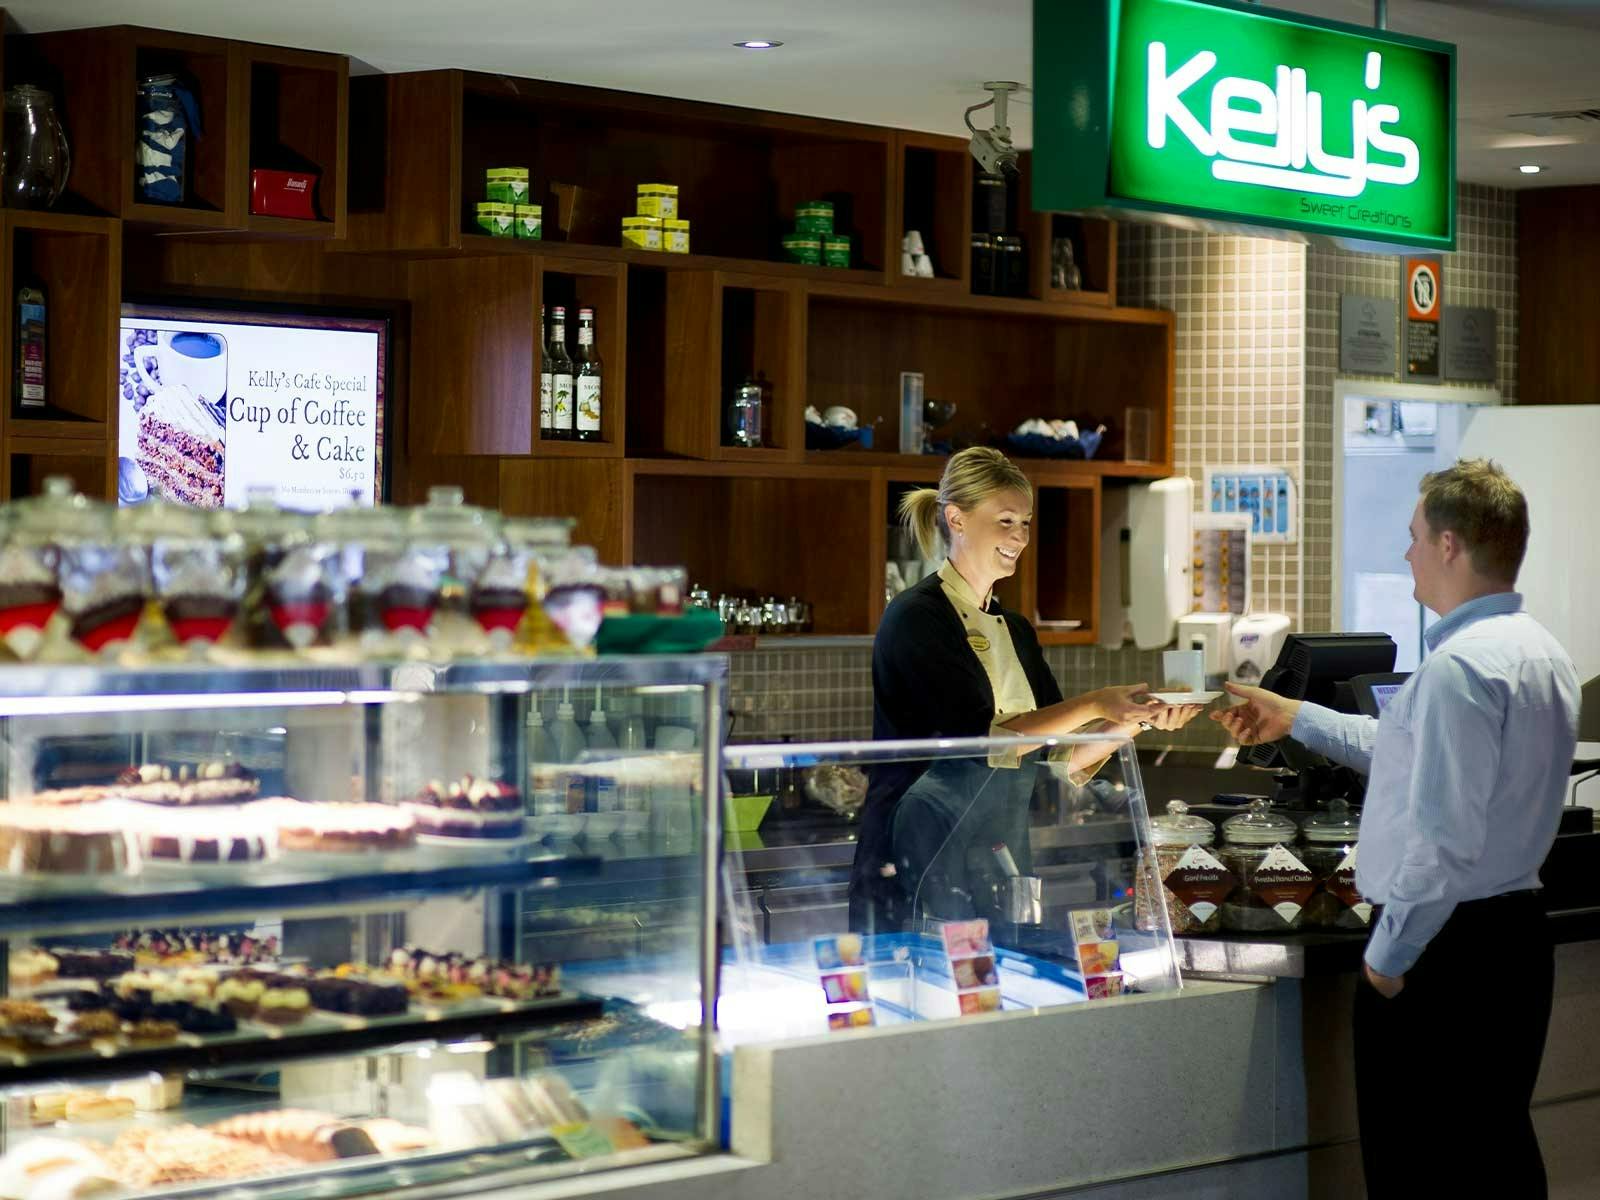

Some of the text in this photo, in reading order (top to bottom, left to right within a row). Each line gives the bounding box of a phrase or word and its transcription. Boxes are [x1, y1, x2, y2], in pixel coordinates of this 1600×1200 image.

[1148, 41, 1419, 197] Kelly's
[1300, 197, 1411, 228] Sweet Creations
[248, 370, 367, 396] Kelly's Cafe Special
[229, 396, 366, 433] Cup of Coffee
[291, 434, 366, 462] & Cake
